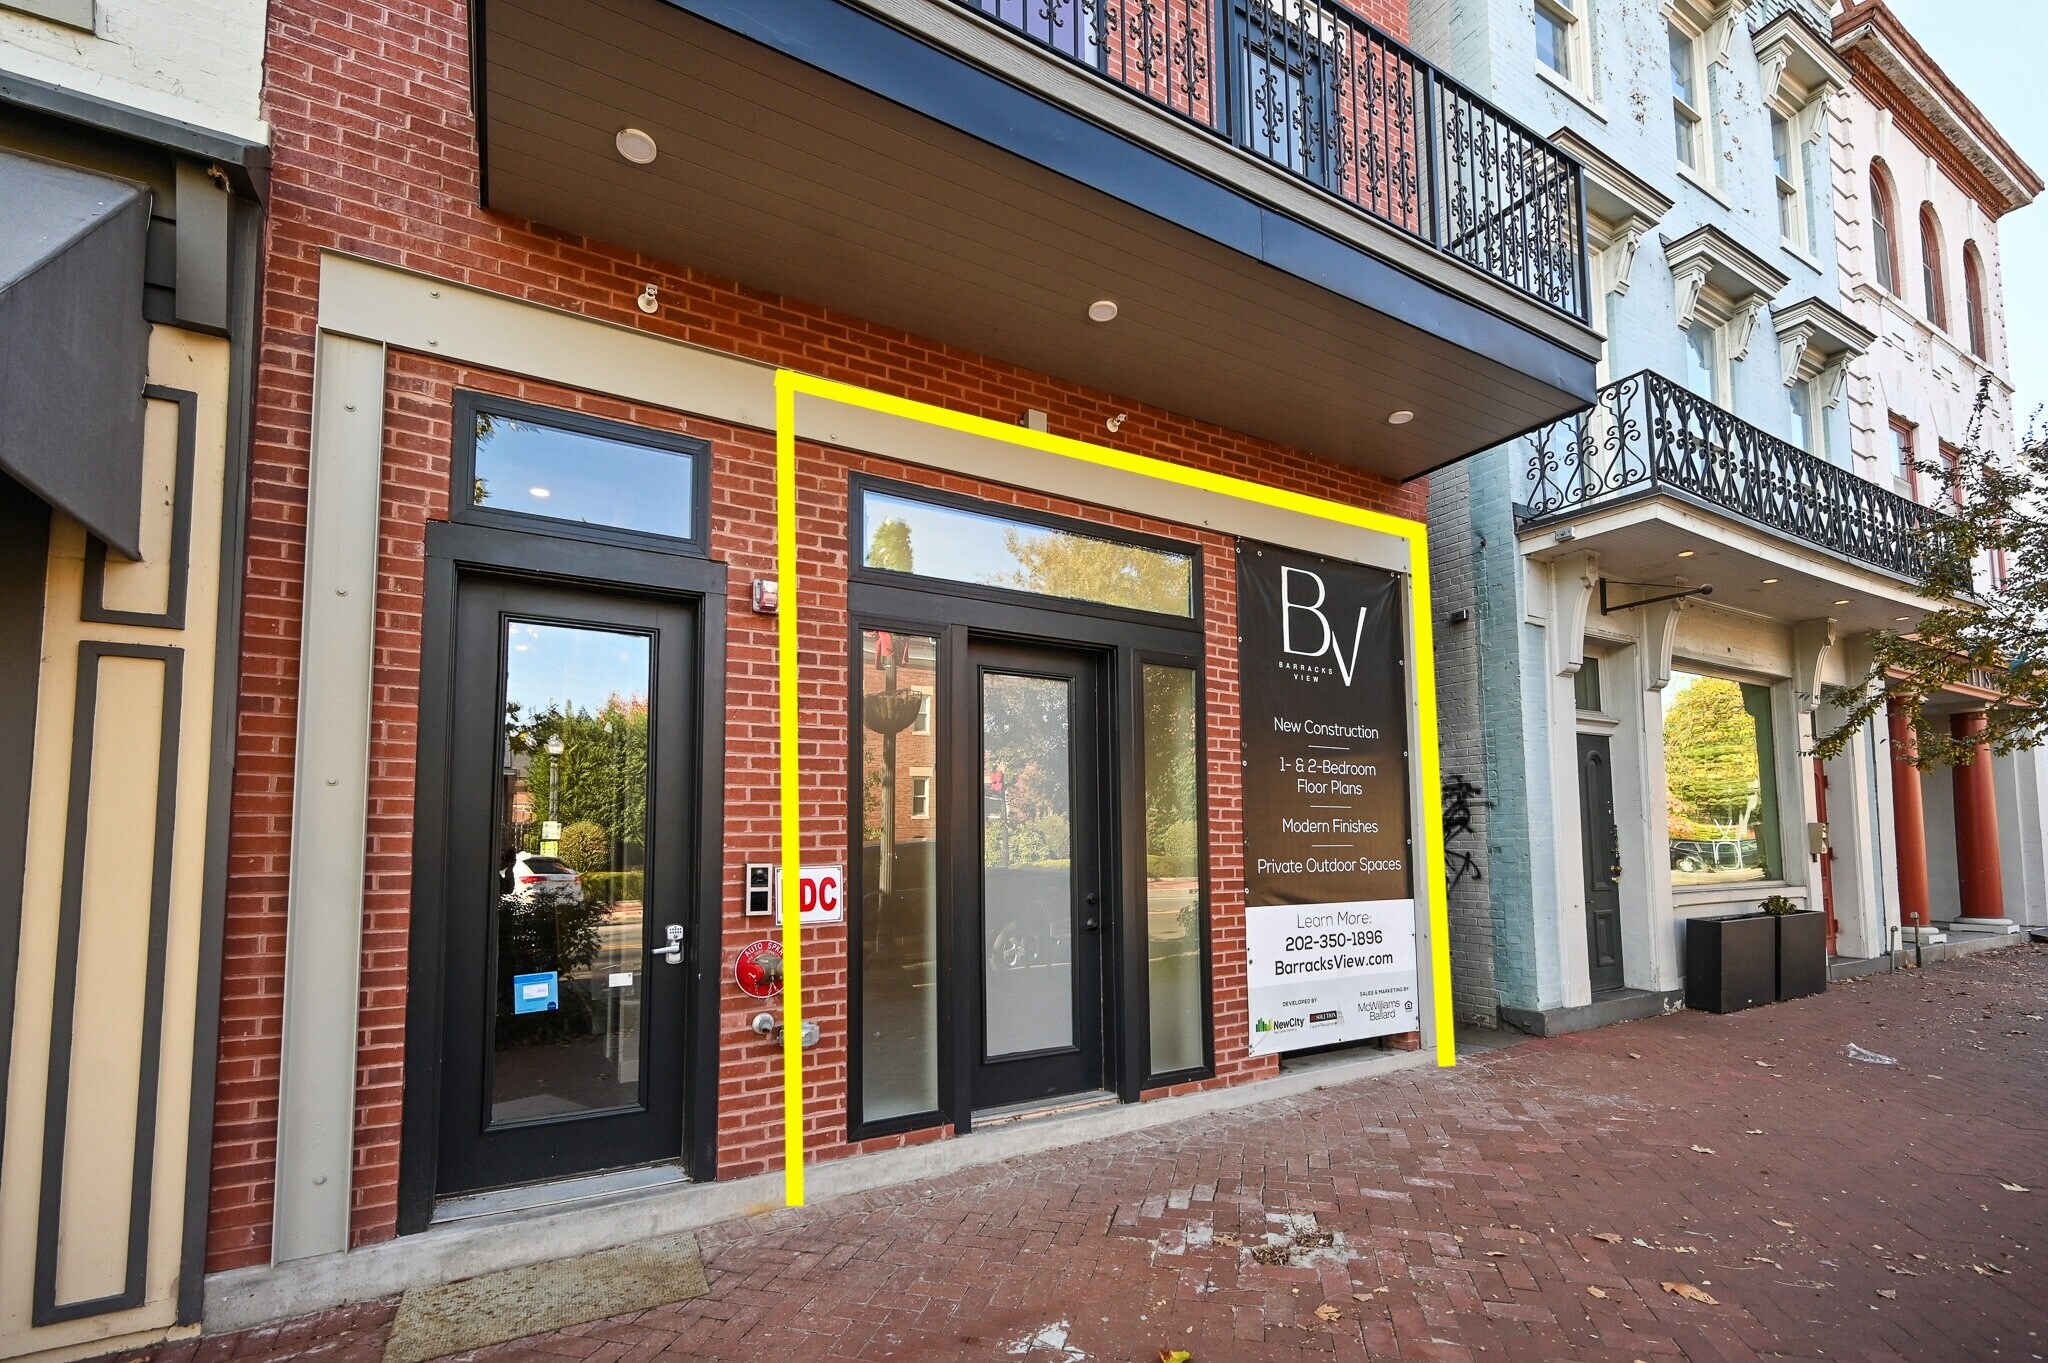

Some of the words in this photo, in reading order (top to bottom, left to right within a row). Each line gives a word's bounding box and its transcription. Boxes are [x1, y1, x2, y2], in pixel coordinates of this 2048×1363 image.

[1278, 661, 1333, 675] BARRACKS
[1293, 673, 1319, 683] VIEW
[1274, 716, 1301, 733] New
[1304, 719, 1379, 739] Construction
[1280, 756, 1291, 772] 1-
[1295, 758, 1304, 773] &
[1308, 758, 1376, 776] 2-Bedroom
[1297, 778, 1328, 793] Floor
[1331, 780, 1363, 795] Plans
[1282, 817, 1330, 833] Modern
[1332, 818, 1379, 834] Finishes
[1257, 858, 1303, 874] Private
[1306, 857, 1357, 873] Outdoor
[1359, 856, 1402, 875] Spaces
[781, 876, 837, 913] DC
[1296, 913, 1334, 929] Learn
[1337, 911, 1372, 926] More:
[1285, 929, 1383, 952] 202-350-1896
[745, 942, 763, 957] AUTO
[1274, 952, 1394, 976] BarracksView.com
[1378, 986, 1403, 995] MARKETING
[1282, 997, 1311, 1007] DEVELOPED
[1357, 1000, 1401, 1012] McWilliams
[1369, 1009, 1396, 1021] Ballard
[1273, 1017, 1305, 1031] NewCity
